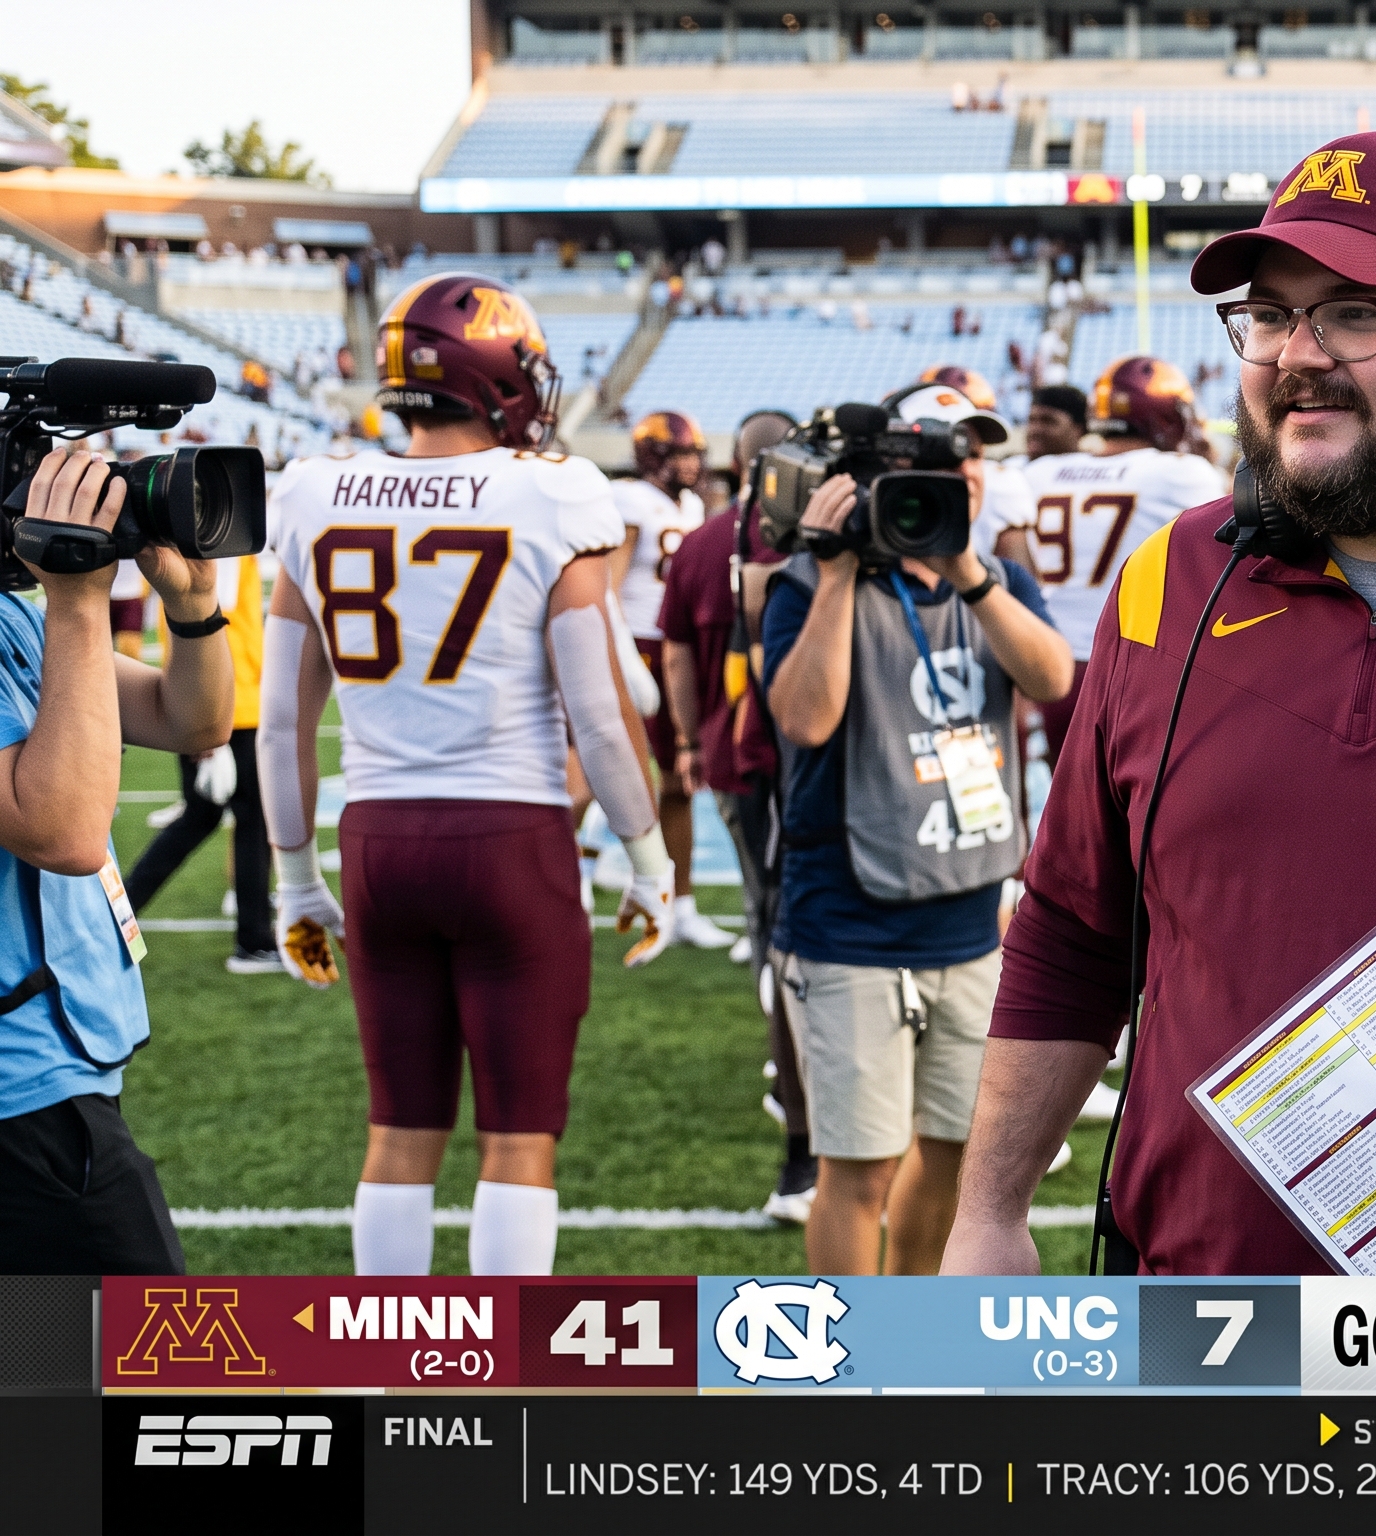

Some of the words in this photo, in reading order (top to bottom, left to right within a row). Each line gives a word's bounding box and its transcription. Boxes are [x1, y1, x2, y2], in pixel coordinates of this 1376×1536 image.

[1274, 149, 1366, 208] M
[332, 474, 489, 509] HARNSEY
[1035, 493, 1138, 588] 97
[311, 523, 514, 686] 87
